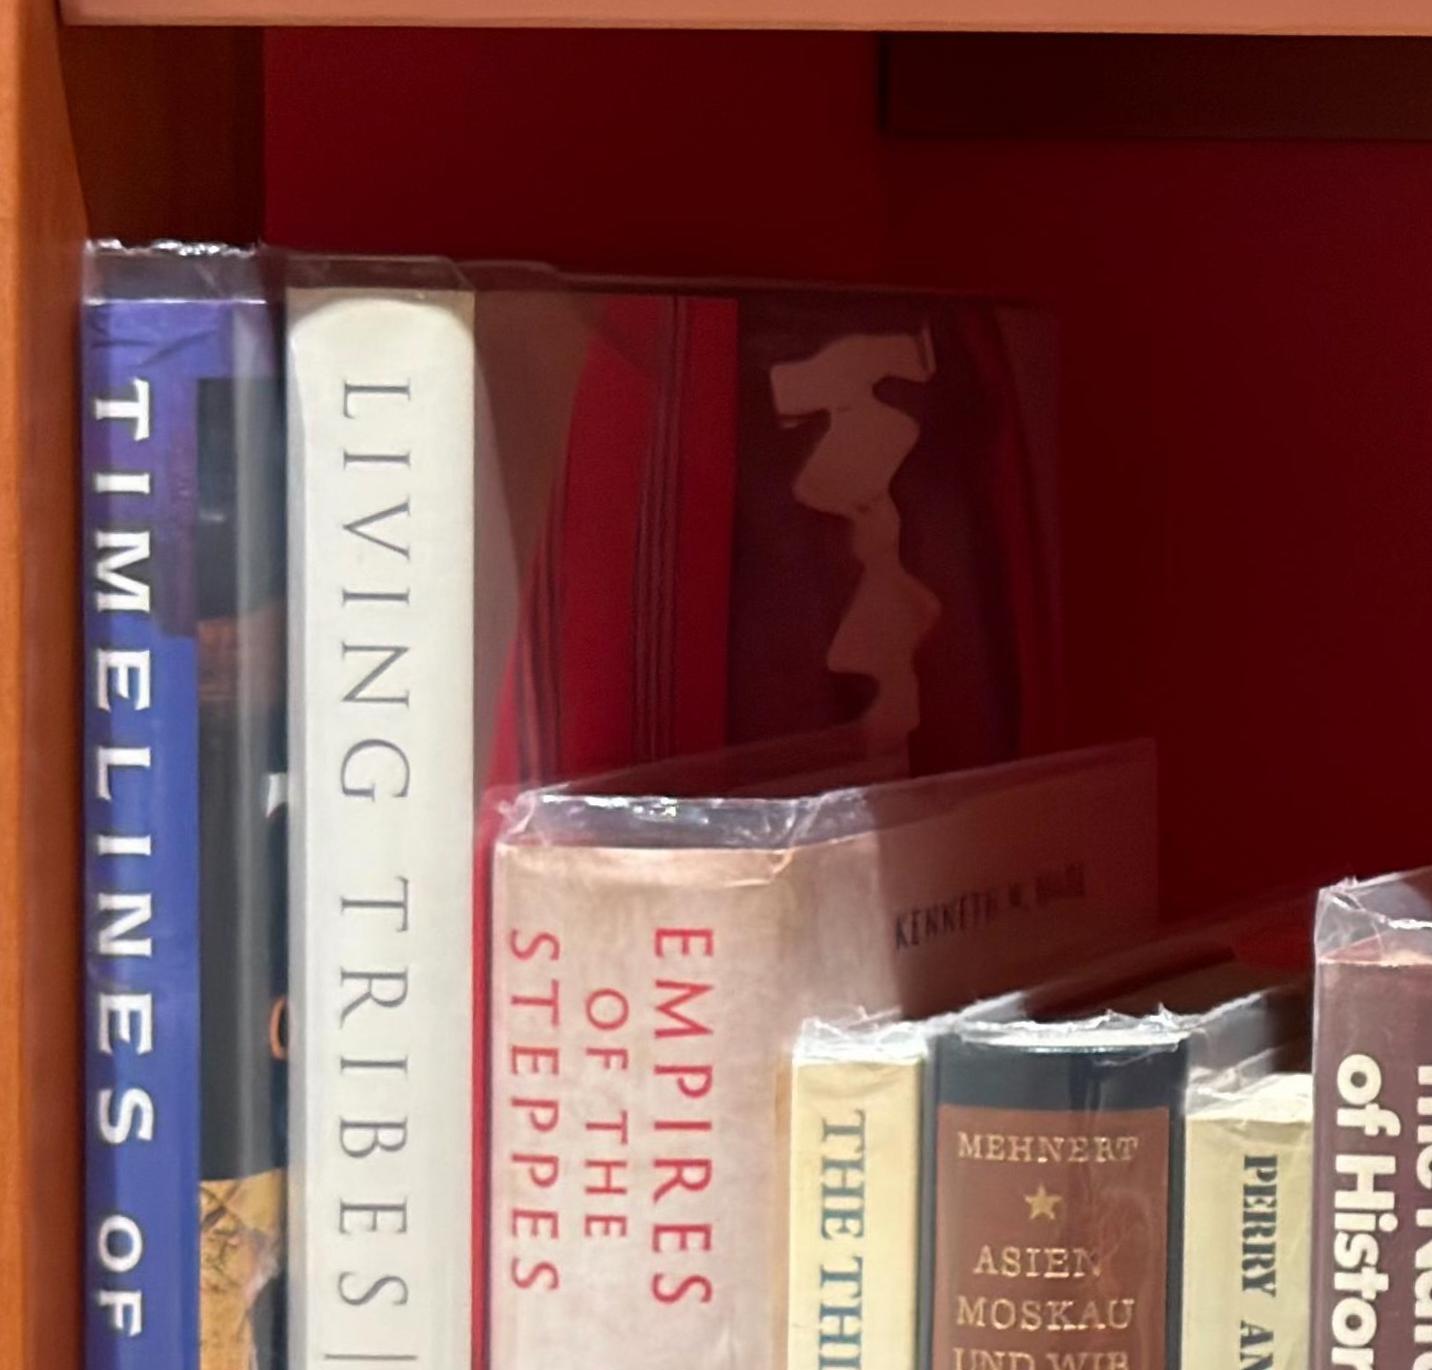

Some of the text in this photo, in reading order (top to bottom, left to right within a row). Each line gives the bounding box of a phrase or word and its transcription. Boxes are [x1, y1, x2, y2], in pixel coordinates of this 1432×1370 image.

[338, 379, 411, 804] LIVING
[93, 378, 153, 1147] TIMELINES
[337, 876, 411, 1306] TRIBES
[511, 931, 560, 1292] STEPPES
[584, 987, 629, 1237] OF THE
[652, 928, 714, 1305] EMPIRES
[957, 1131, 1139, 1164] MEHNERT
[1336, 1054, 1401, 1136] of
[819, 1109, 866, 1241] THE
[1241, 1155, 1278, 1298] PERRY
[97, 1214, 143, 1337] OF
[955, 1295, 1135, 1332] MOSKAU
[972, 1244, 1100, 1278] ASIEN
